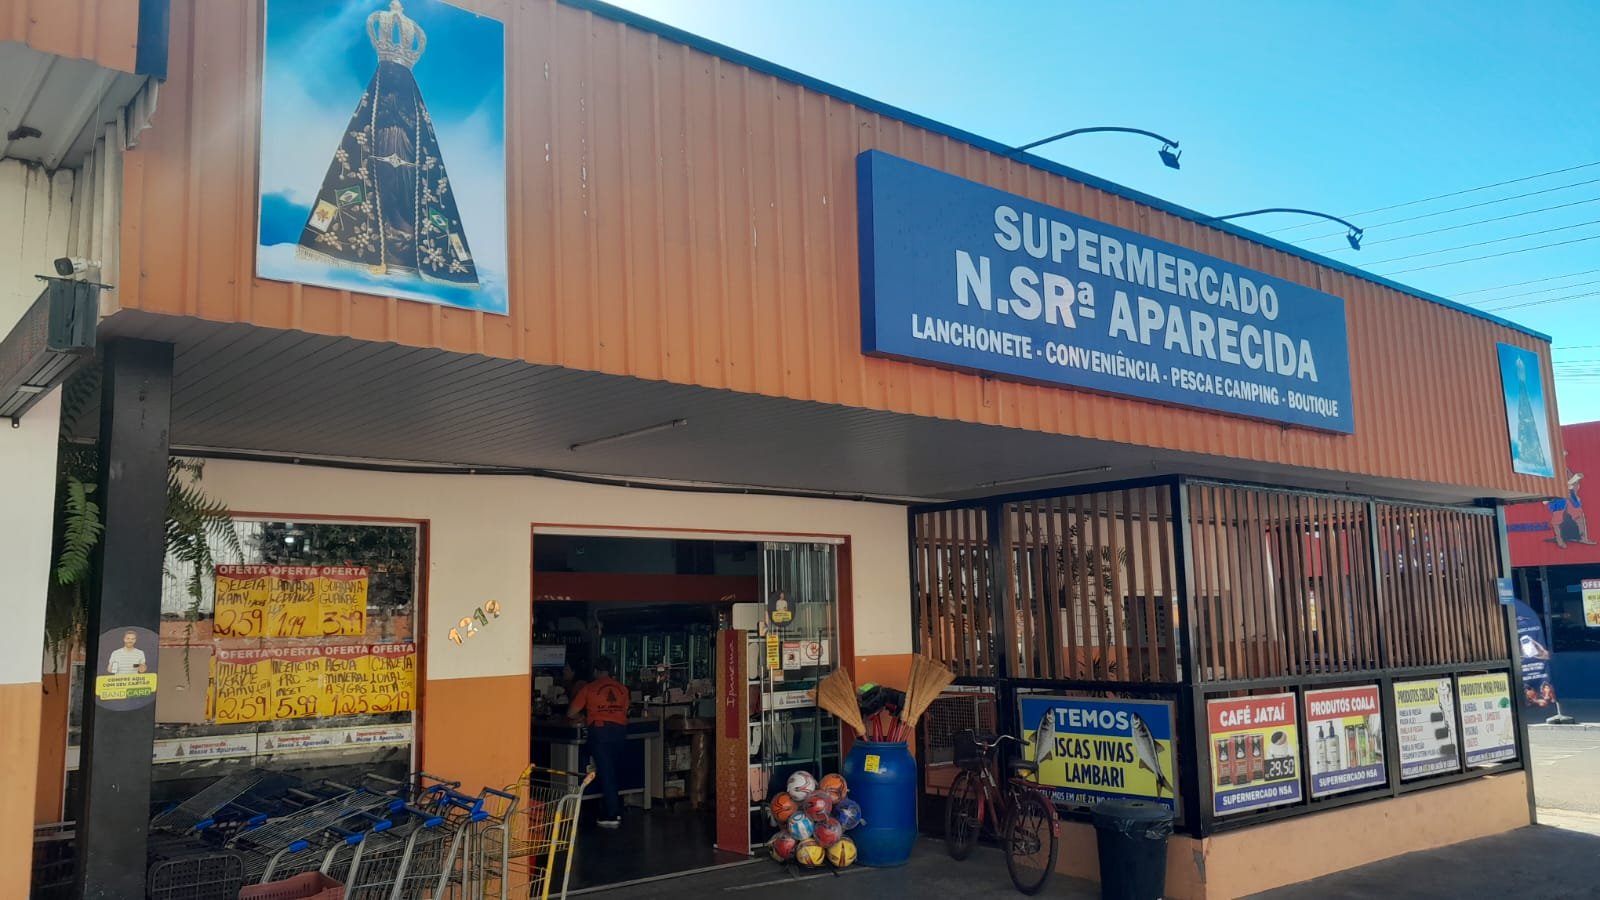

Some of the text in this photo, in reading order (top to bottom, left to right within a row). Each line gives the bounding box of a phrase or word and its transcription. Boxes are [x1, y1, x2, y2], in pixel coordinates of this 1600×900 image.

[993, 205, 1280, 321] SUPERMERCADO
[1108, 290, 1319, 382] APARECIDA
[911, 313, 1033, 359] LANCHONETE
[1045, 342, 1160, 383] CONVENIÊNCIA
[1170, 366, 1214, 394] PESCA
[1215, 375, 1224, 396] E
[1224, 379, 1279, 405] CAMPING
[1288, 390, 1339, 418] BOUTIQUE
[219, 565, 268, 574] OFERTA
[270, 566, 319, 576] OFERTA
[322, 566, 367, 576] OFERTA
[213, 608, 263, 637] 2,59
[220, 649, 268, 659] OFERTA
[275, 647, 321, 657] OFERTA
[325, 645, 369, 655] OFERTA
[372, 644, 414, 654] OFERTA
[1397, 687, 1420, 704] PRODUTOS
[1460, 682, 1482, 696] PRODUTOS
[218, 696, 267, 720] 2,59
[275, 694, 318, 719] 5,99
[1219, 703, 1286, 727] CAFÉ JATAÍ
[1310, 696, 1376, 717] PRODUTOS COALA
[1055, 707, 1130, 731] TEMOS
[1054, 736, 1135, 763] ISCAS VIVAS
[1064, 762, 1125, 788] LAMBARI
[1318, 768, 1378, 787] SUPERMERCADO NSA
[1065, 792, 1075, 801] EM
[1075, 793, 1086, 803] ATÉ
[1222, 786, 1293, 806] SUPERMERCADO NSA
